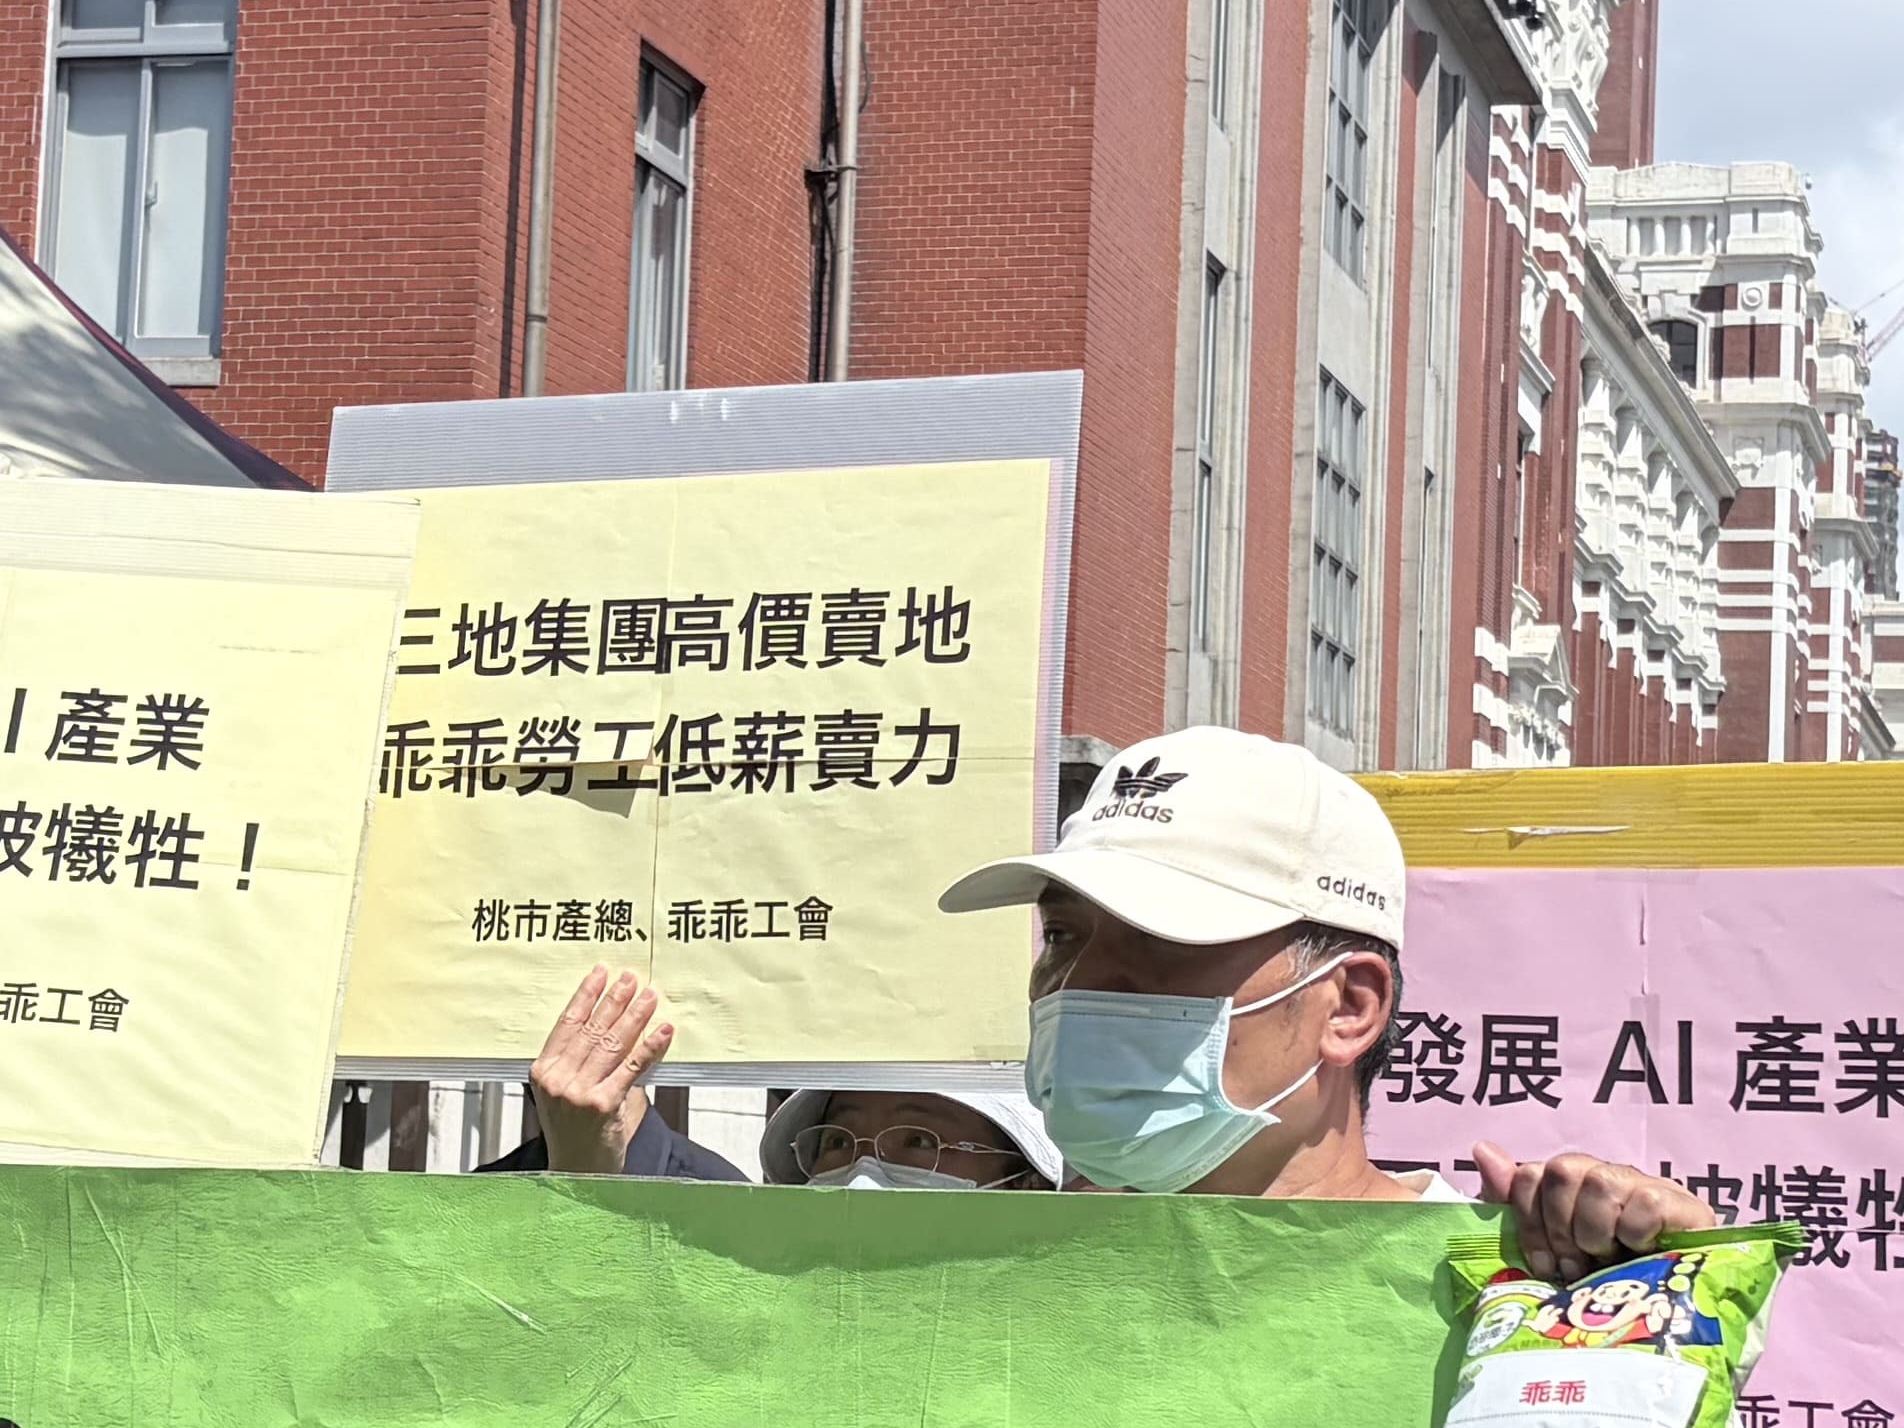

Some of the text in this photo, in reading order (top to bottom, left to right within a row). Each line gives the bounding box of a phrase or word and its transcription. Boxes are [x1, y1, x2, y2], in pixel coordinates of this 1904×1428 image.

[396, 585, 972, 677] 三地集團高價賣地
[43, 688, 209, 771] 產業
[376, 704, 964, 799] 乖乖勞工低薪賣力
[1091, 798, 1175, 825] adidas
[1316, 873, 1388, 912] adidas
[1379, 1011, 1561, 1110] 發展
[1594, 1017, 1694, 1106] AI
[1519, 1378, 1587, 1406] 乖乖
